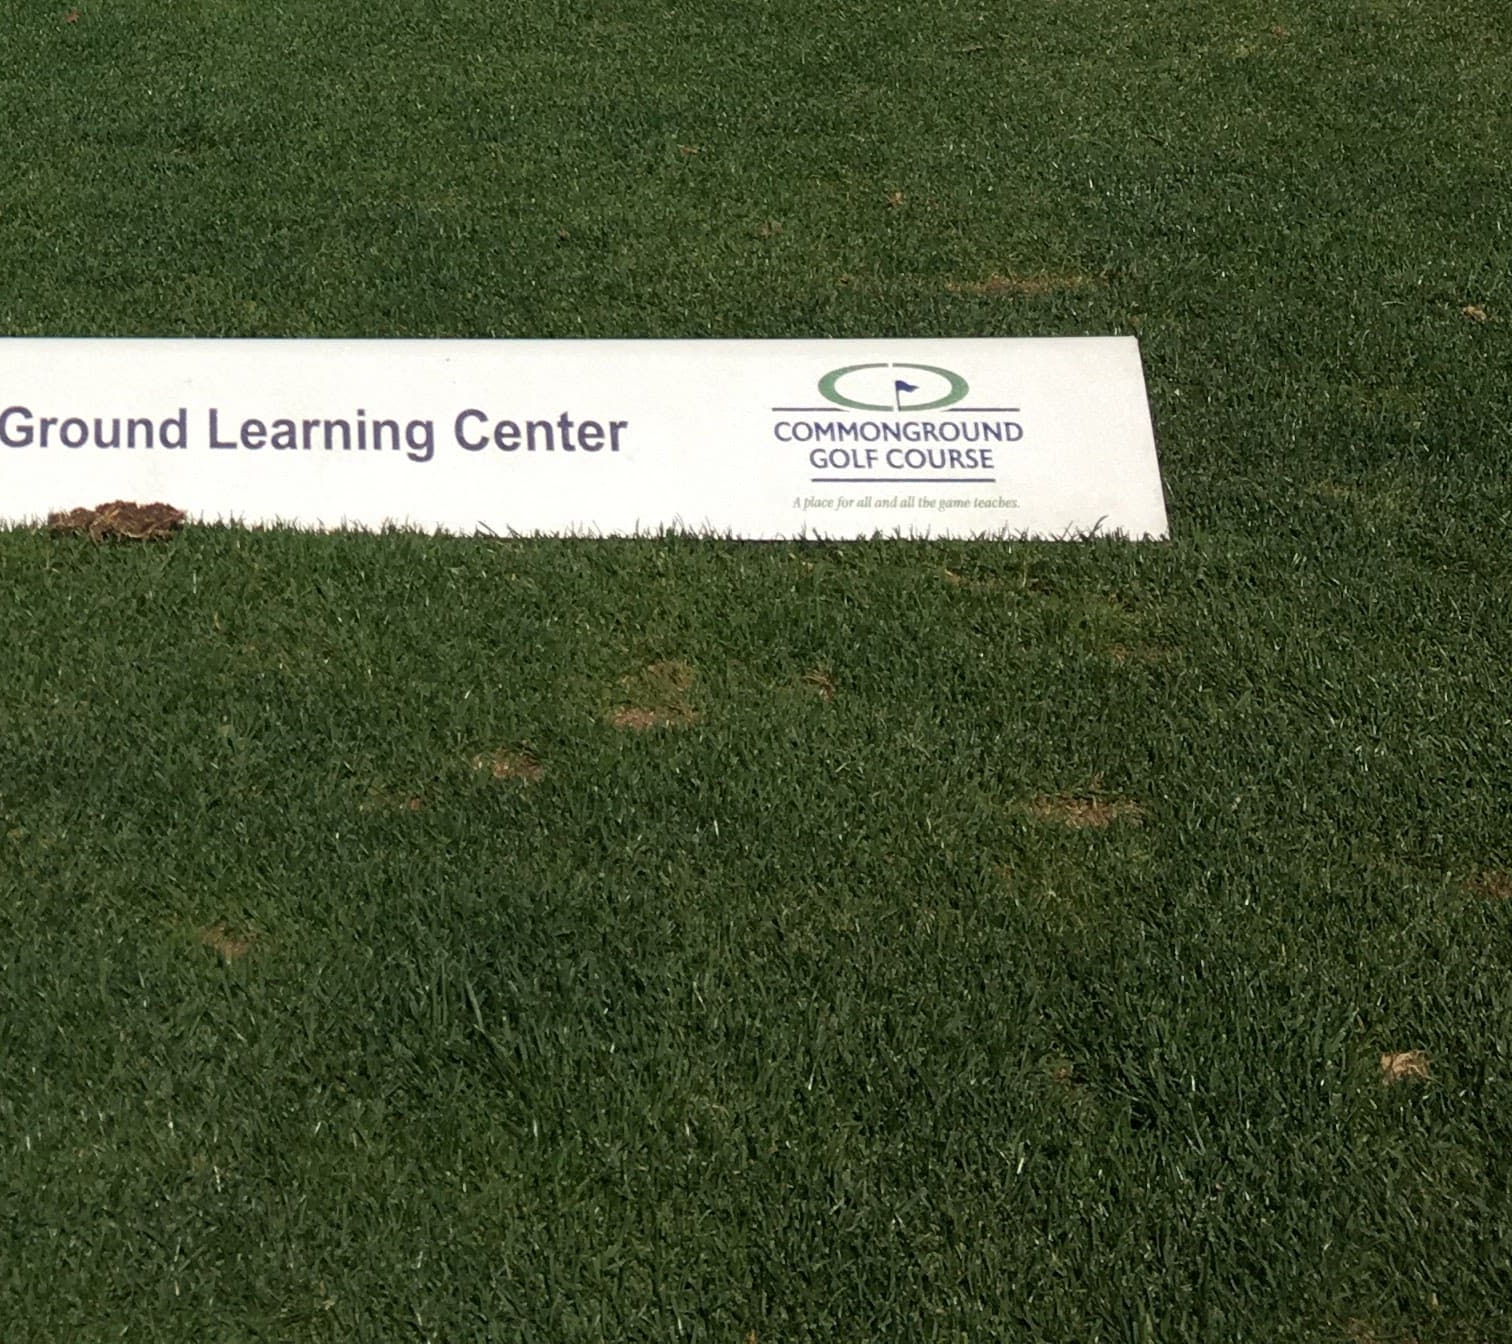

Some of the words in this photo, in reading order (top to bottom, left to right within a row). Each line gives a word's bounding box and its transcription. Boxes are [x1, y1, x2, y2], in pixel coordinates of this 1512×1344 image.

[206, 407, 436, 461] Learning
[453, 409, 630, 454] Center
[774, 421, 1024, 442] COMMONGROUND
[809, 448, 878, 469] GOLF
[886, 448, 995, 469] COURSE
[792, 496, 801, 508] A
[803, 496, 834, 511] place
[835, 496, 854, 511] for
[856, 496, 872, 509] all
[874, 496, 898, 509] and
[899, 496, 915, 509] all
[917, 496, 937, 509] the
[938, 499, 971, 512] game
[973, 497, 1021, 509] teaches.
